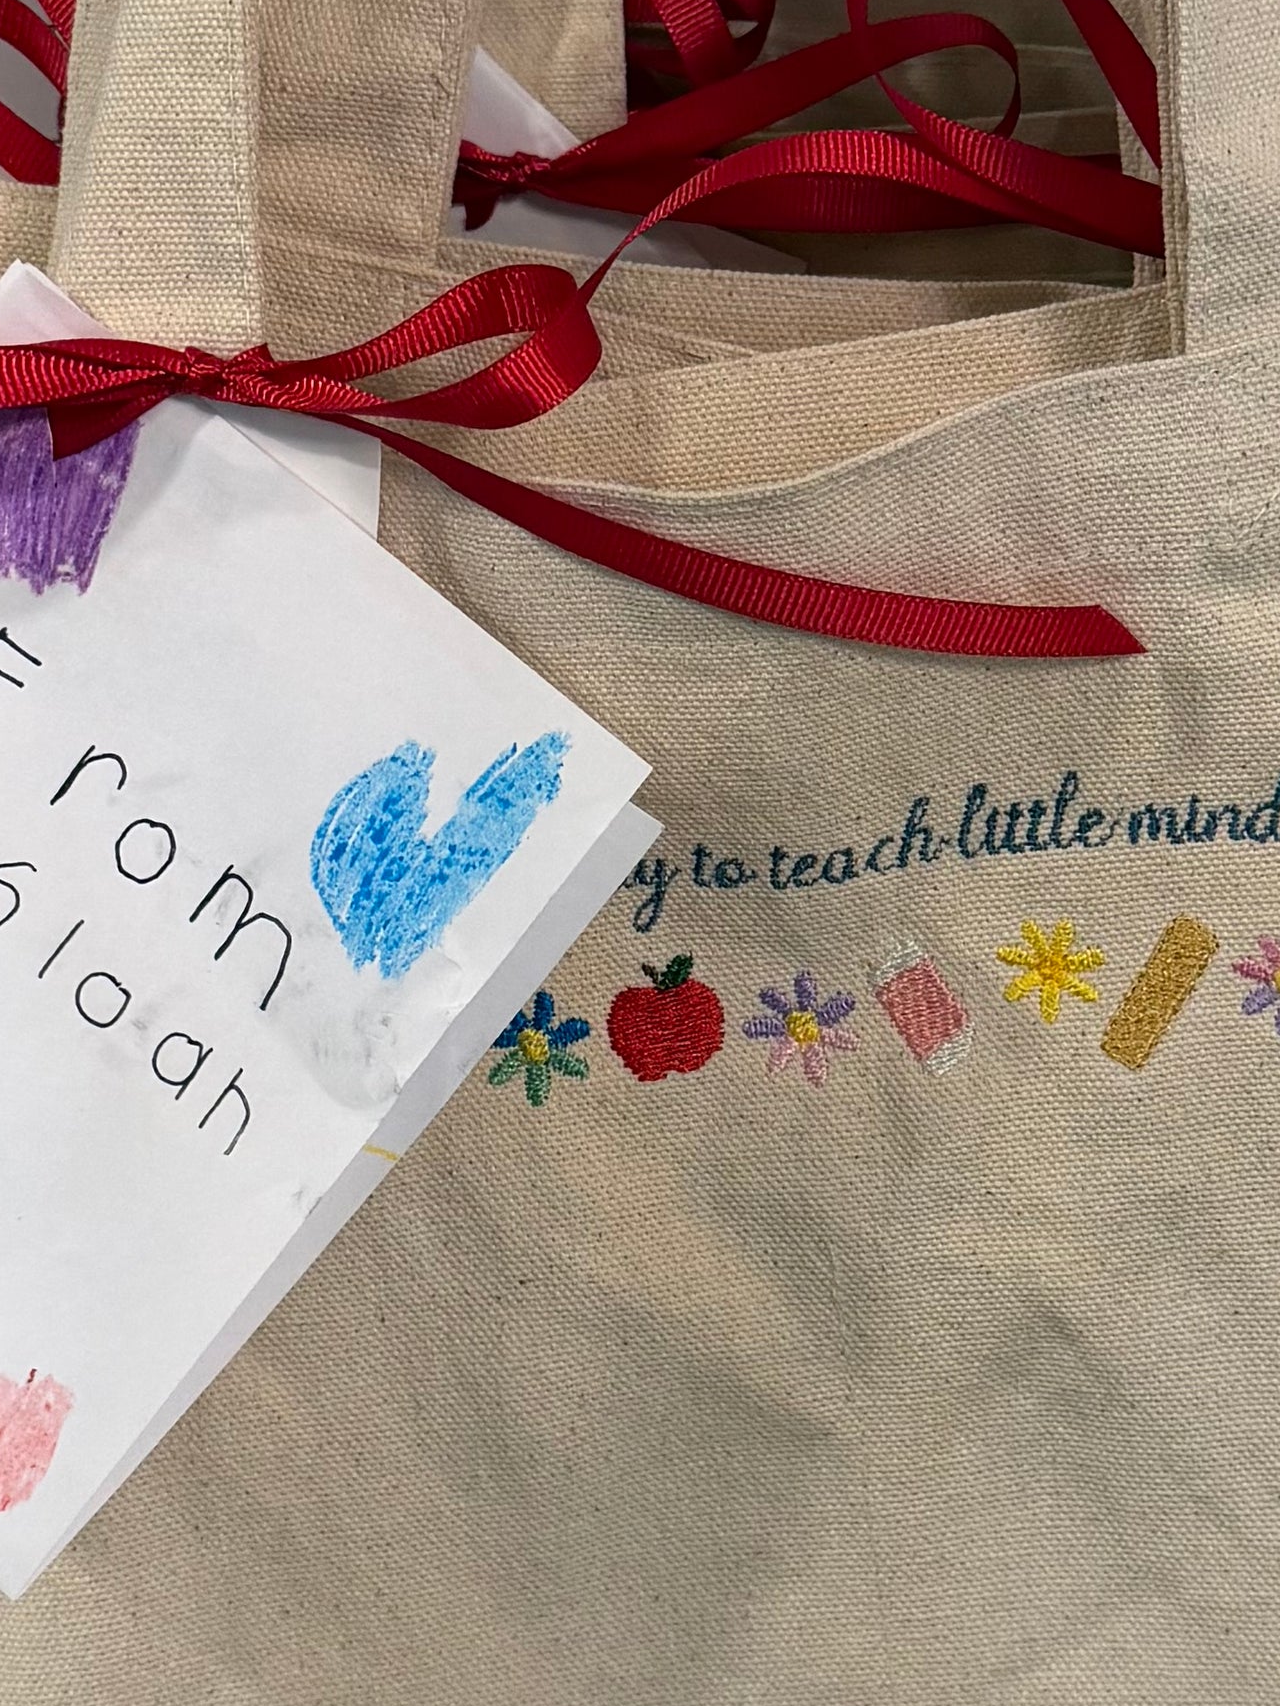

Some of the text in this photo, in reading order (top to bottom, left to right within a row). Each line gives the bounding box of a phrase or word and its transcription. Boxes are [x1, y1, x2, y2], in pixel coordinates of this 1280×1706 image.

[691, 842, 757, 889] to
[769, 795, 951, 890] teach
[957, 769, 1120, 860] little
